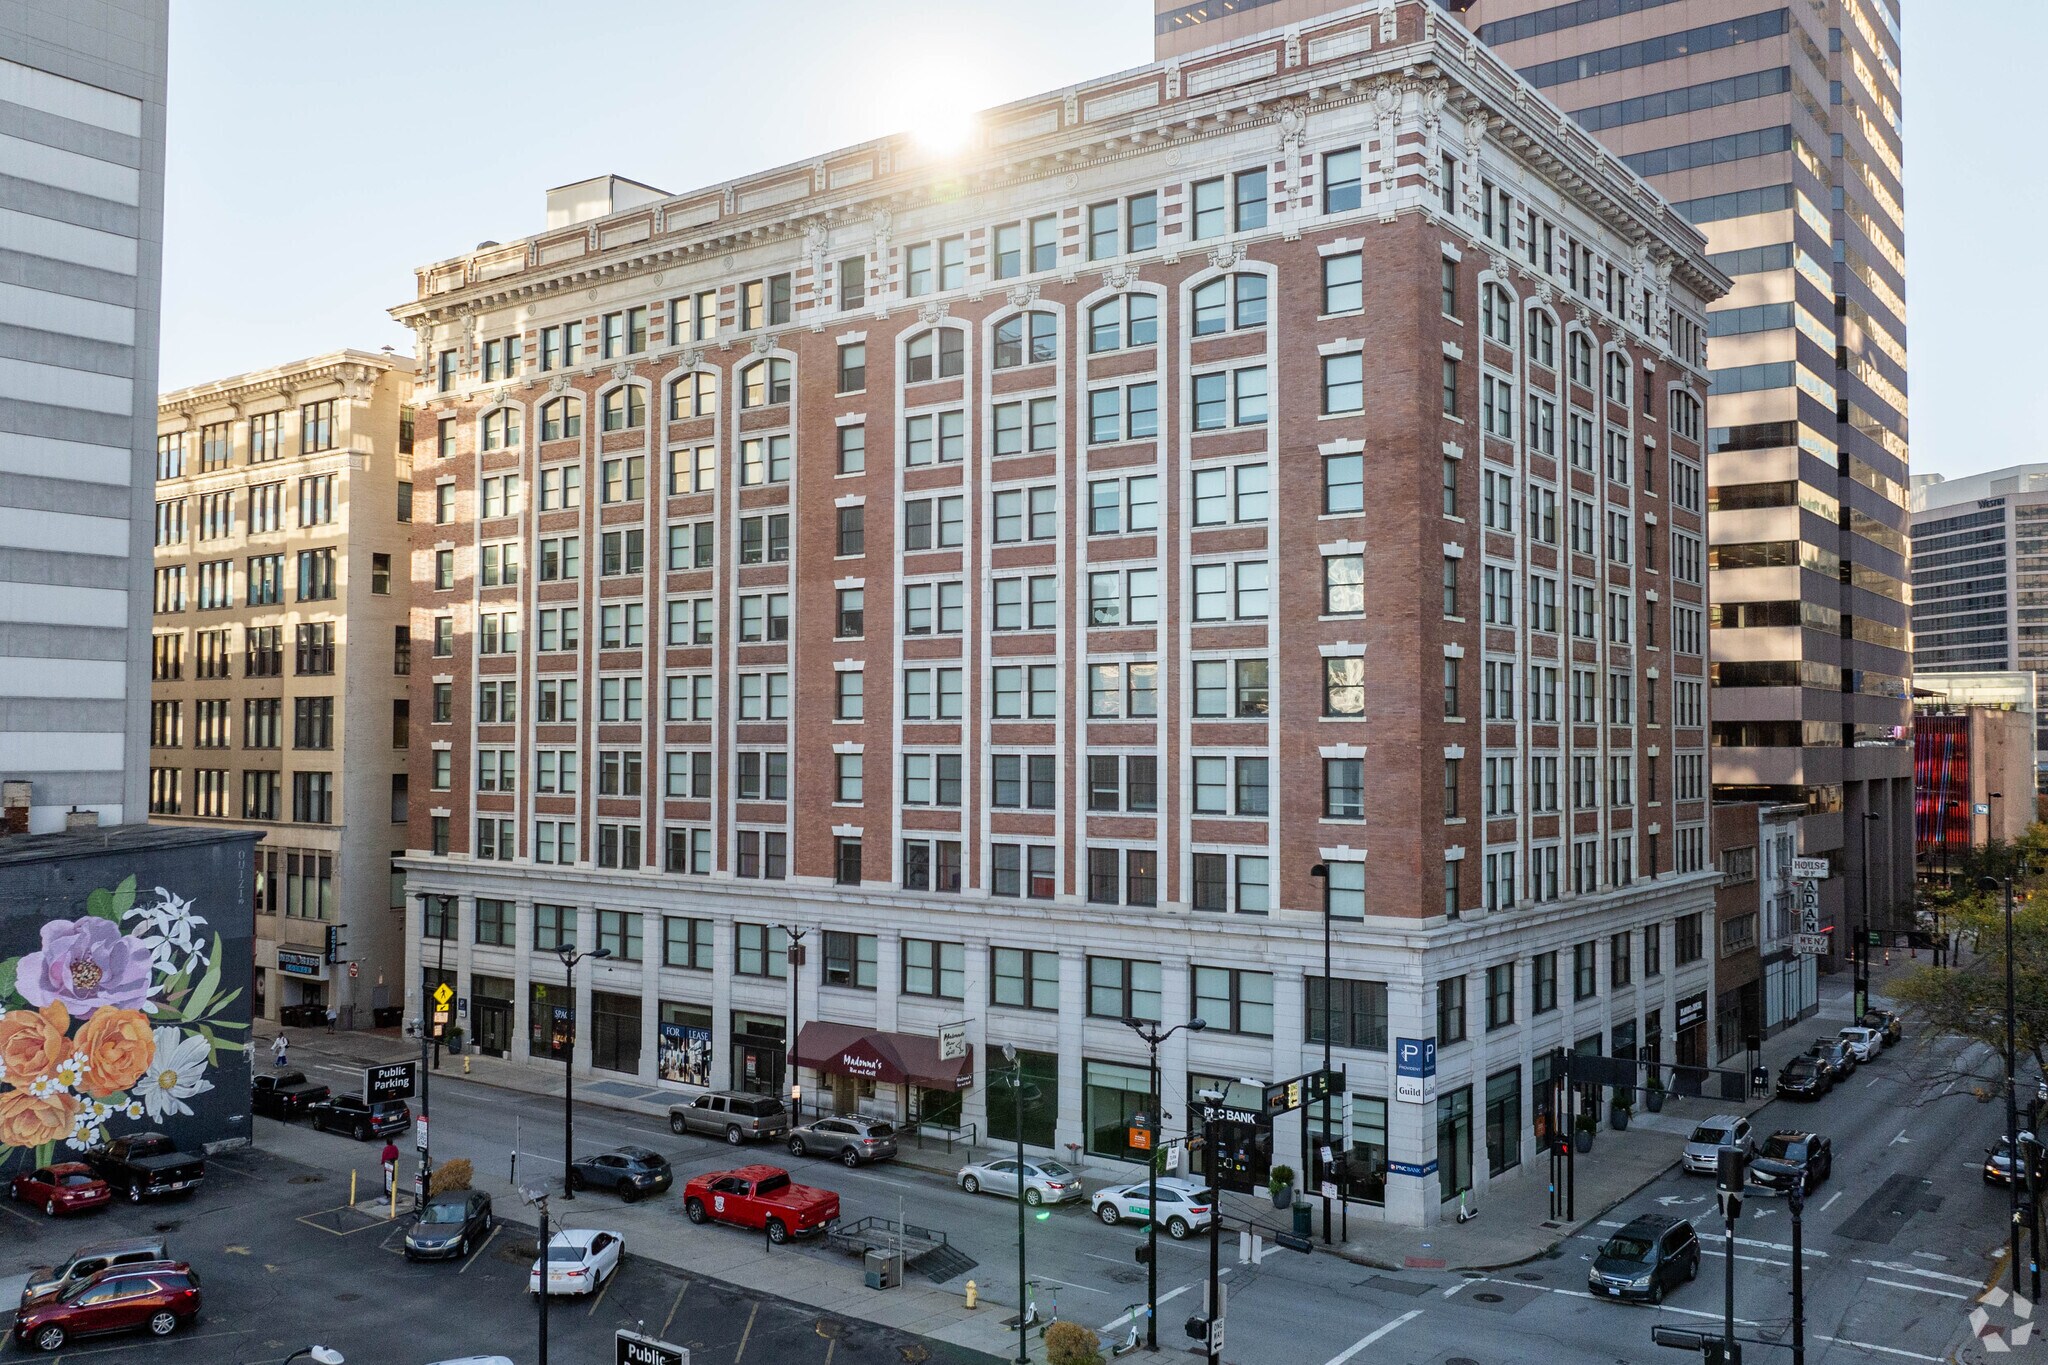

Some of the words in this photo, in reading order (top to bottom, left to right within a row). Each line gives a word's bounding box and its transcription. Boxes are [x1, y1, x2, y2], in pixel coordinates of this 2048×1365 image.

[1977, 498, 2005, 509] WESTIN
[1794, 861, 1827, 870] HOUSE
[1805, 881, 1816, 932] ADAM
[1801, 945, 1827, 953] WEAR
[666, 1026, 680, 1036] FOR
[688, 1030, 708, 1040] LEASE
[843, 1054, 882, 1069] Madonna's
[379, 1067, 406, 1079] Public
[375, 1077, 409, 1091] Parking
[1399, 1086, 1421, 1096] Guild
[1226, 1110, 1256, 1124] BANK
[628, 1343, 666, 1365] Public
